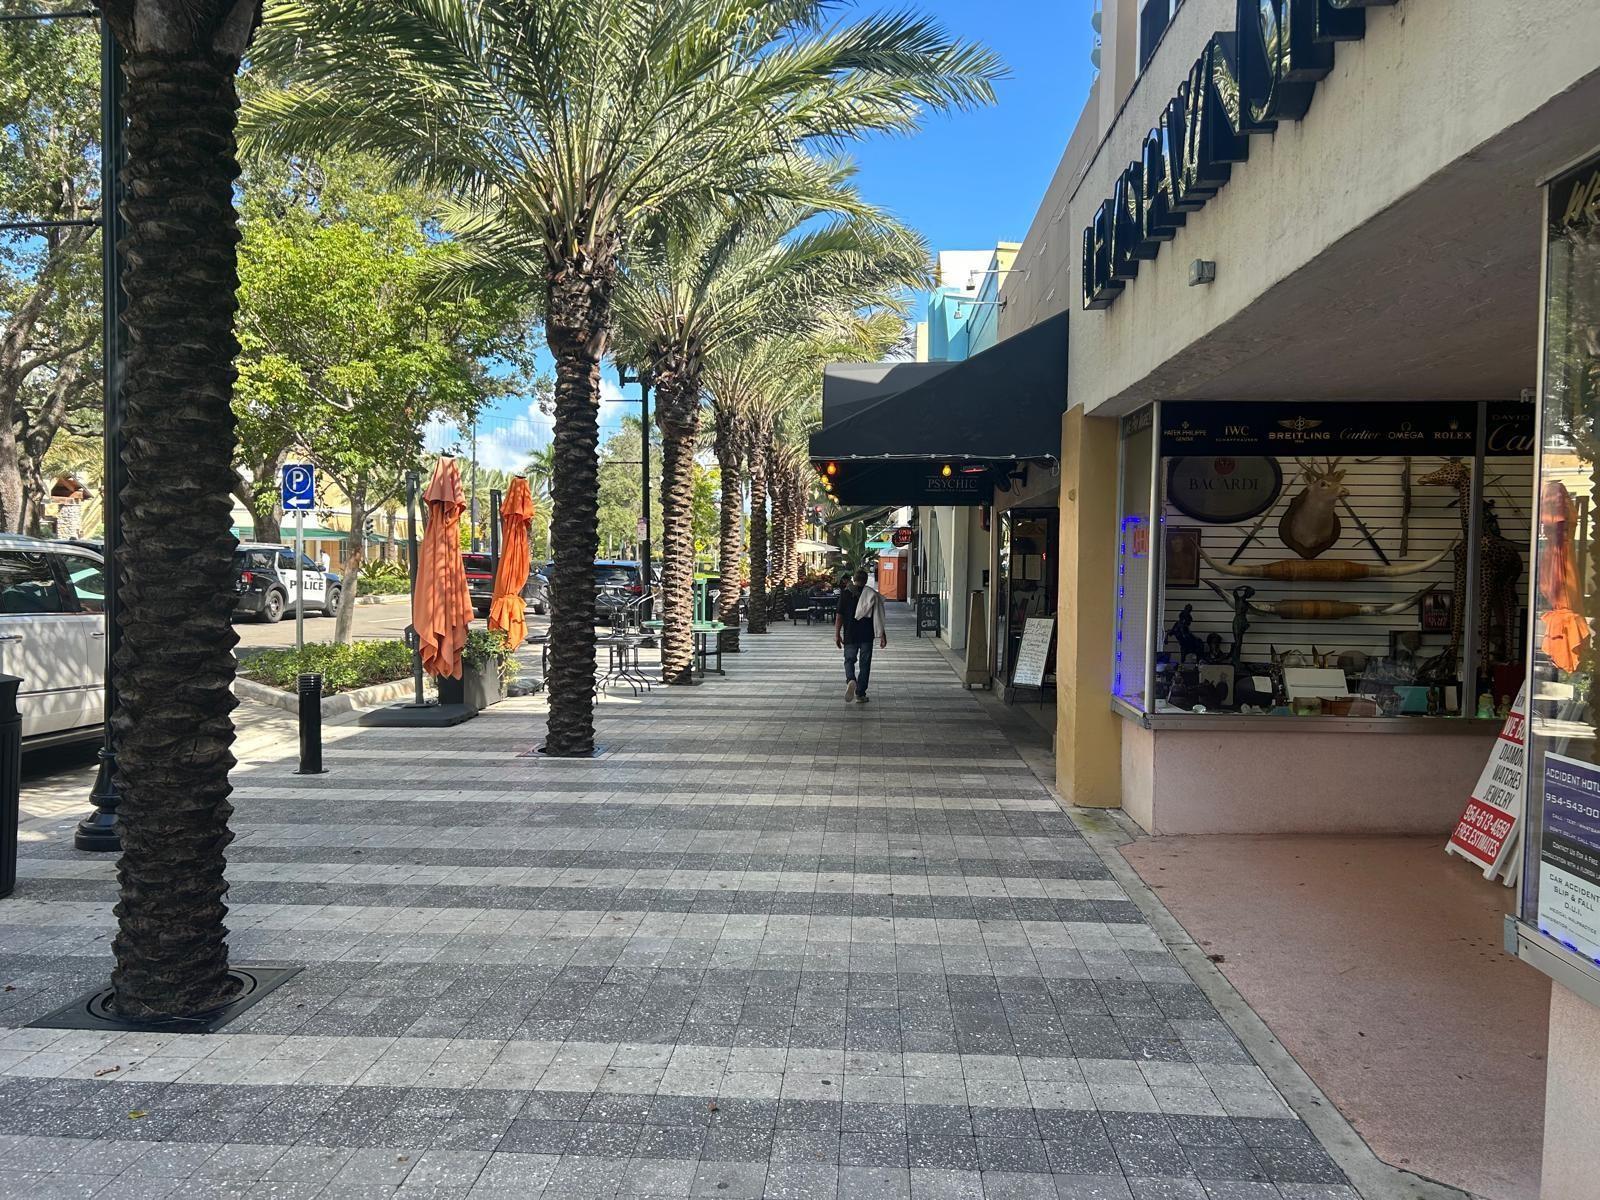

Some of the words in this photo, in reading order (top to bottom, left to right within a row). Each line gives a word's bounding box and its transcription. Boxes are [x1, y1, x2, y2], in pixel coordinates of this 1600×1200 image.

[1225, 425, 1249, 436] IWC
[1268, 431, 1331, 441] BREITLING
[1339, 426, 1379, 440] Cartier
[1388, 431, 1424, 440] OMEGA
[1434, 431, 1473, 440] ROLEX
[292, 470, 304, 491] P
[927, 479, 977, 489] PSYCHIC
[1189, 477, 1259, 490] BACARDI
[290, 580, 324, 591] PLICE
[1502, 715, 1520, 737] WE
[1492, 765, 1522, 791] WATCHES
[1546, 767, 1580, 786] ACCIDENT
[1483, 784, 1515, 810] JEWELRY
[1545, 792, 1600, 819] 954-543-00
[1454, 821, 1474, 842] FREE
[1467, 827, 1500, 859] ESTIMATES
[1549, 873, 1563, 885] CAR
[1554, 885, 1569, 898] SLIP
[1571, 894, 1576, 902] &
[1577, 898, 1595, 912] FALL
[1567, 916, 1597, 935] MALPRACTICE
